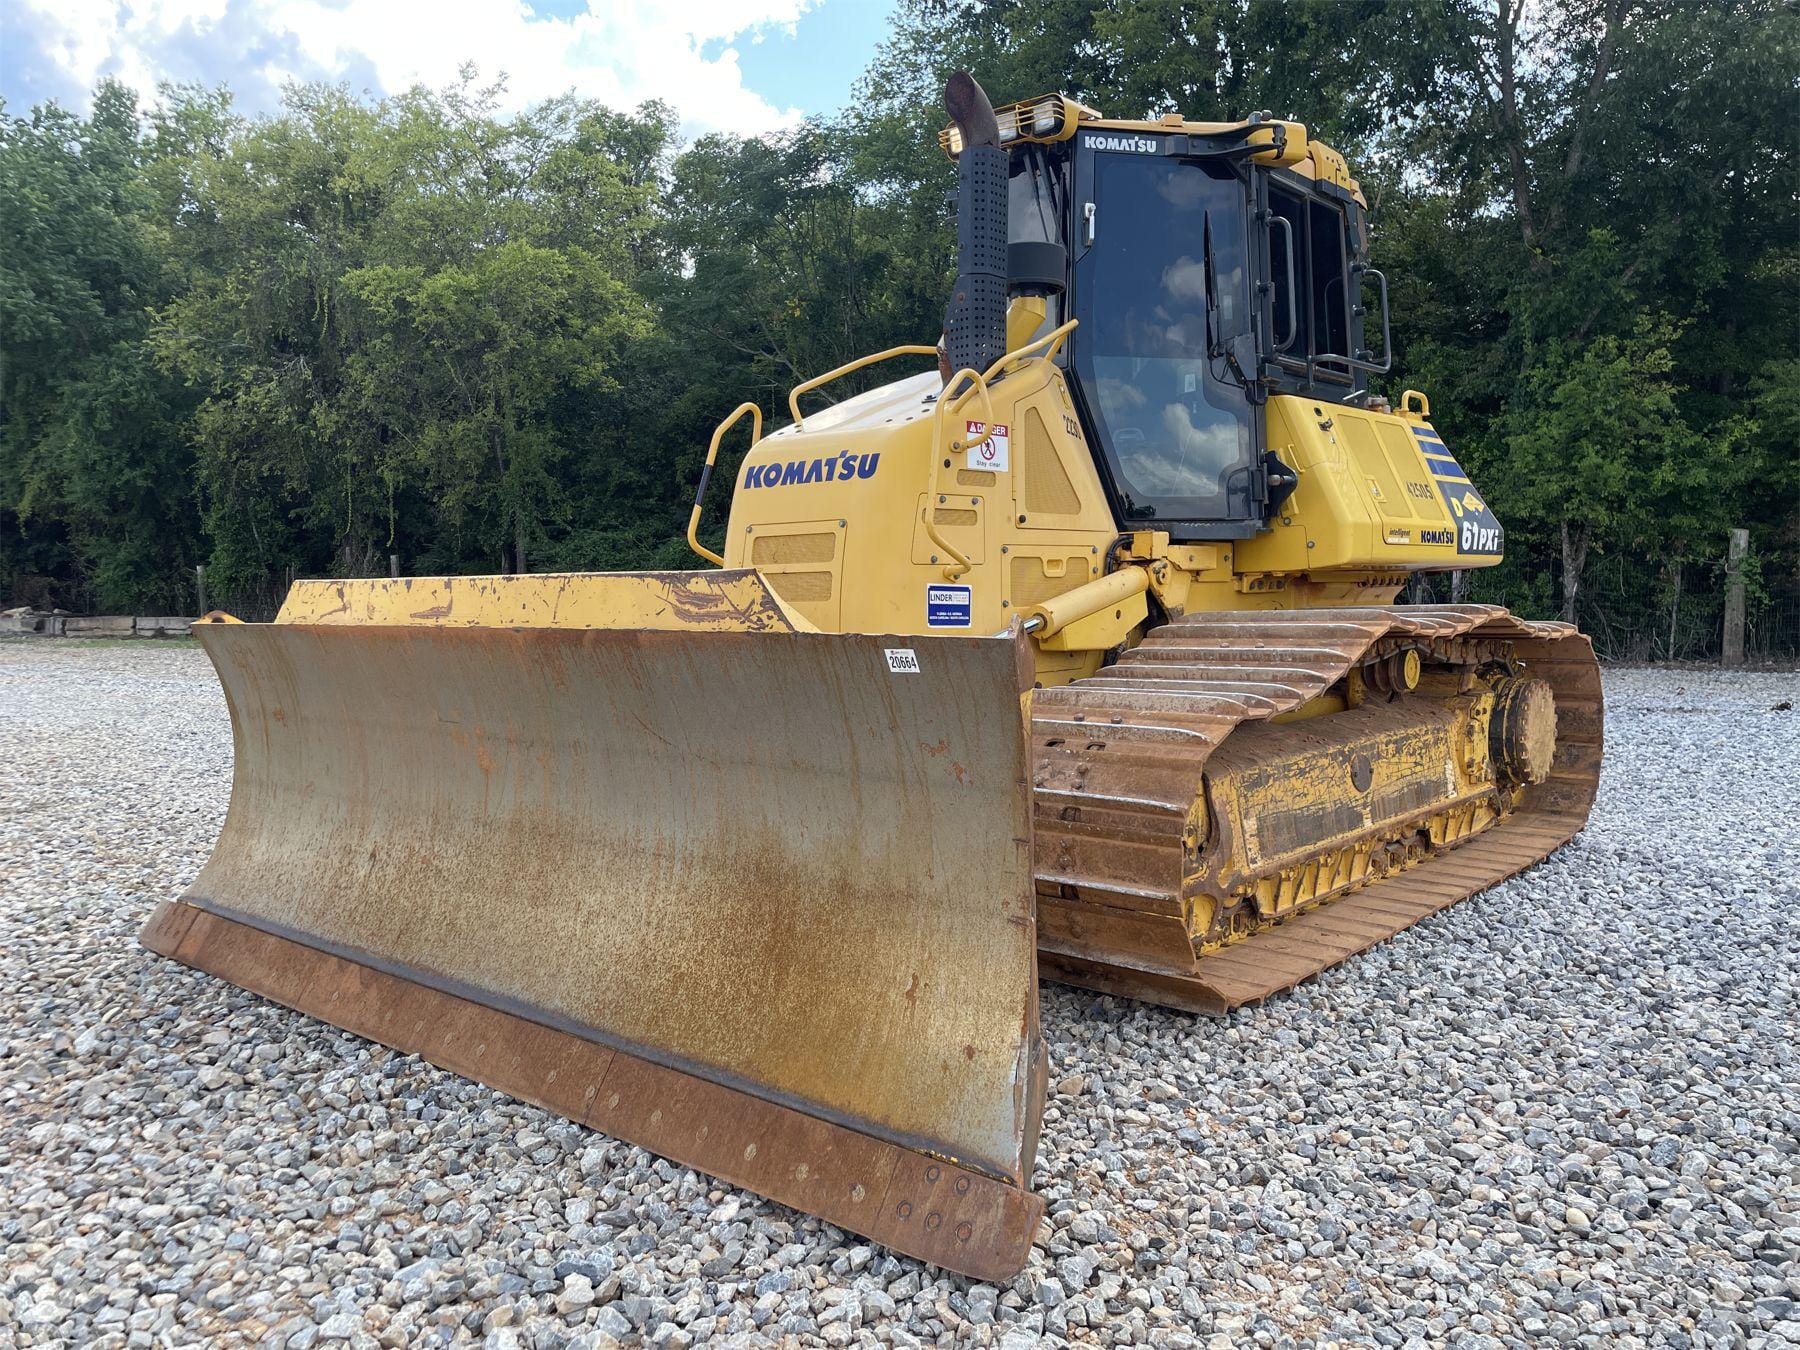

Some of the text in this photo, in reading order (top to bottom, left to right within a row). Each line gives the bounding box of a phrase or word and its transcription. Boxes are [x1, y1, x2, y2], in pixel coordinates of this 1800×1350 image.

[1084, 136, 1157, 153] KOMATSU
[977, 423, 1006, 435] DAGER
[743, 450, 881, 489] KOMATSU
[976, 459, 987, 468] Stay
[1421, 527, 1455, 545] KOMATSU
[930, 593, 953, 602] LINDER
[889, 656, 917, 669] 20664
